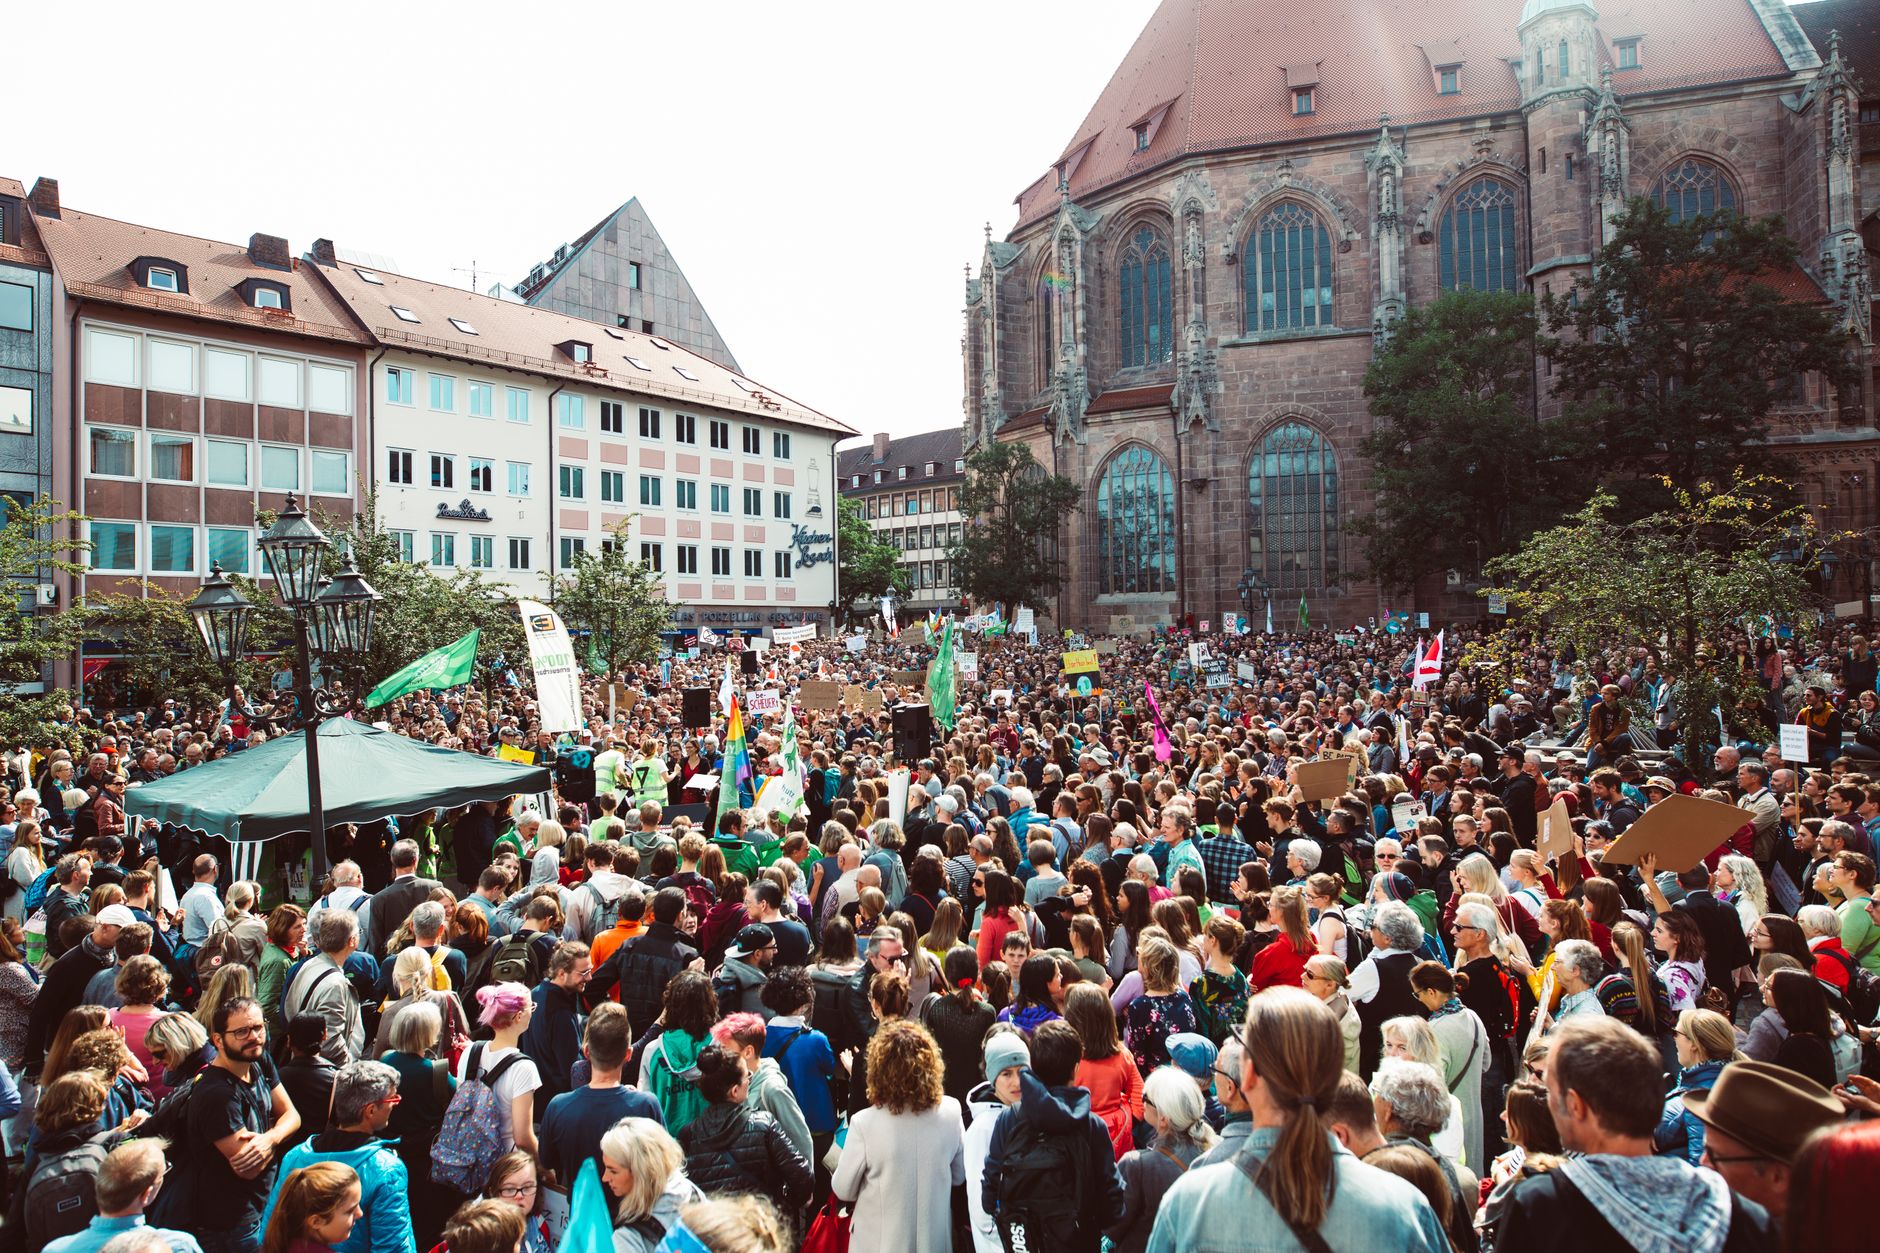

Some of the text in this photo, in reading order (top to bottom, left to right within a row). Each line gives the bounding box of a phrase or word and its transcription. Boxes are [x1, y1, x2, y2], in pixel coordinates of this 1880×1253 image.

[702, 611, 761, 622] PORZELLAN
[768, 611, 824, 622] GESCHNKE
[964, 671, 977, 680] IOT
[1322, 751, 1334, 760] BE
